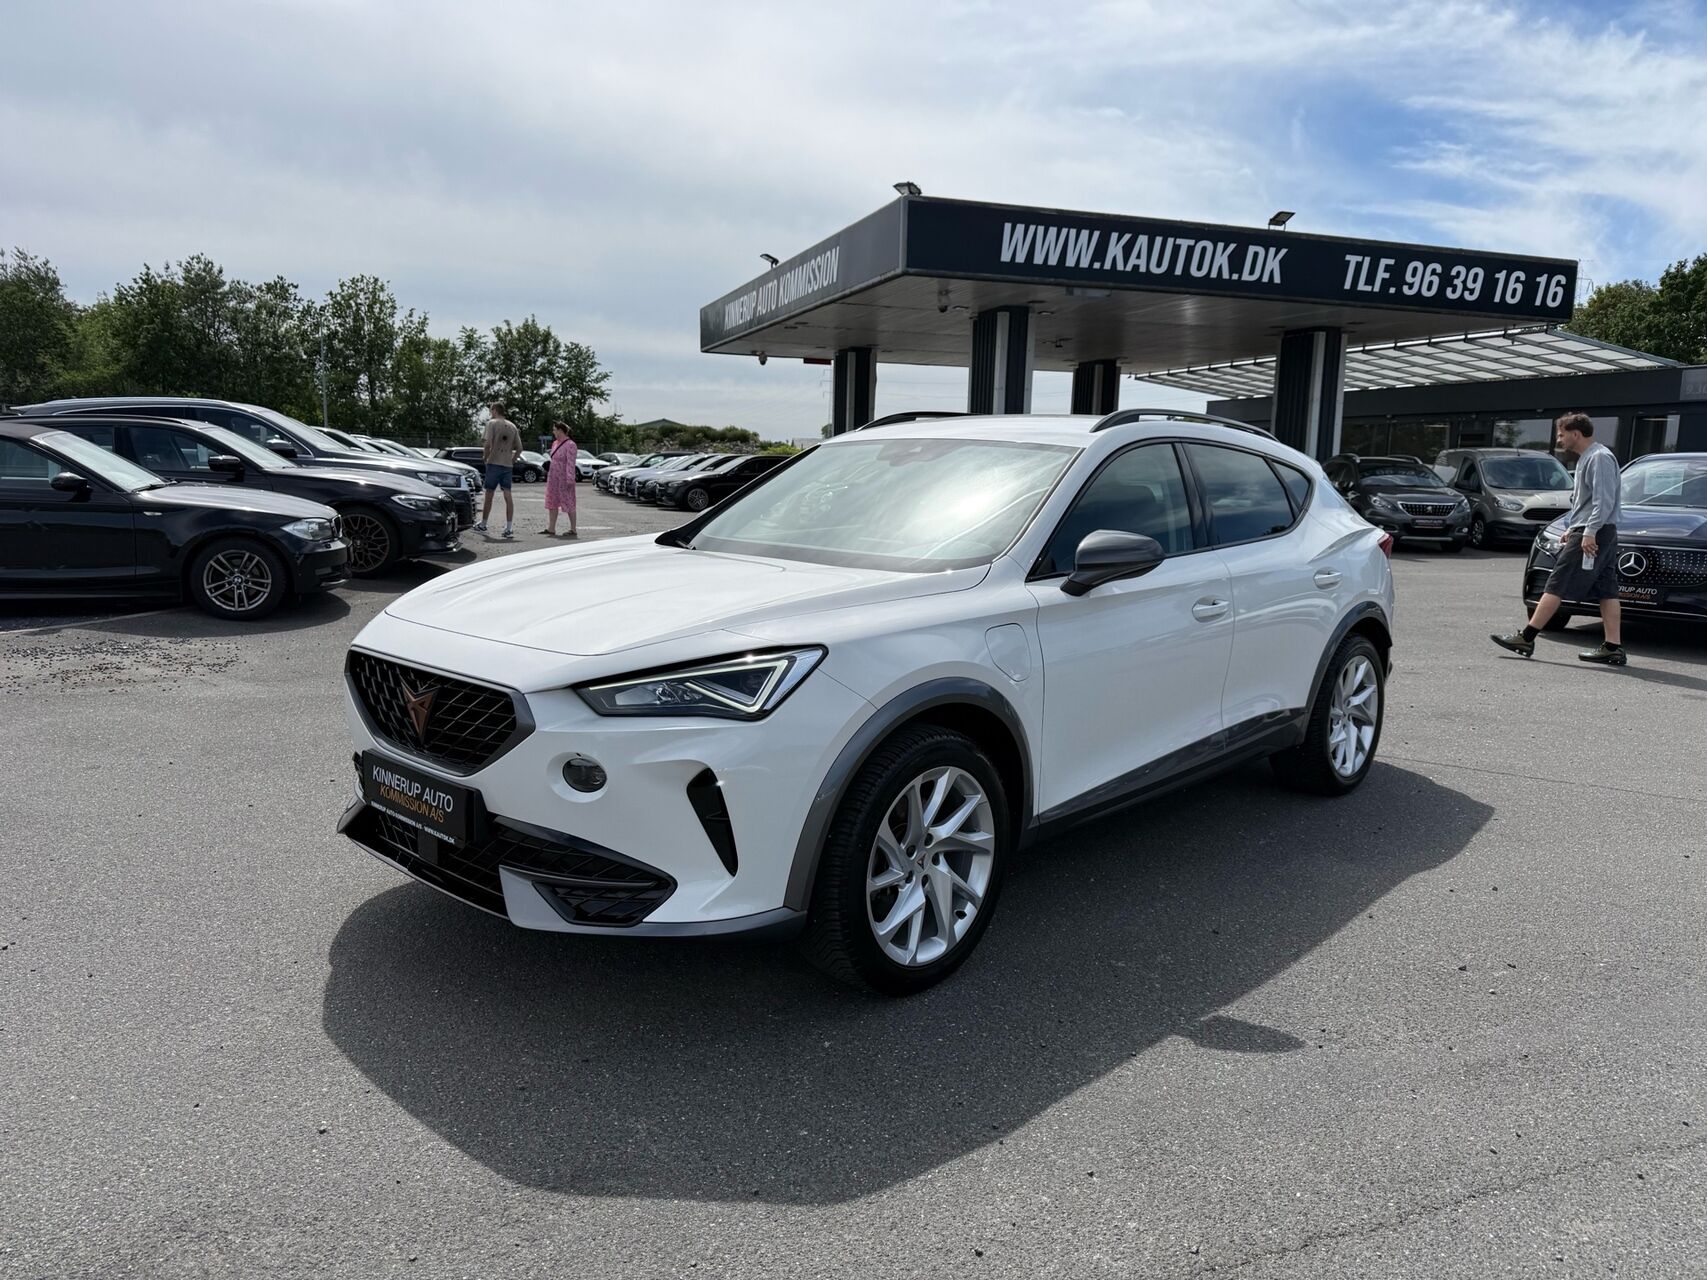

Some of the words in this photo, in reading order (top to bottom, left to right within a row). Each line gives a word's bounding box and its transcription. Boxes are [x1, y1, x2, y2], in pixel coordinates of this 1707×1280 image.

[1000, 222, 1287, 283] WWW.KAUTOK.DK
[724, 291, 757, 331] KINNERUP
[756, 279, 778, 317] AUTO
[778, 246, 840, 307] KOMMISSION
[1343, 254, 1396, 294] TLF.
[1402, 260, 1443, 298] 96
[1445, 265, 1485, 302] 39
[1493, 269, 1526, 305] 16
[1534, 273, 1567, 308] 16
[1636, 587, 1657, 595] AUTO
[372, 765, 421, 797] KINNERUP
[423, 787, 453, 812] AUTO
[379, 784, 430, 816] KOMMISSION
[429, 806, 445, 823] A/S
